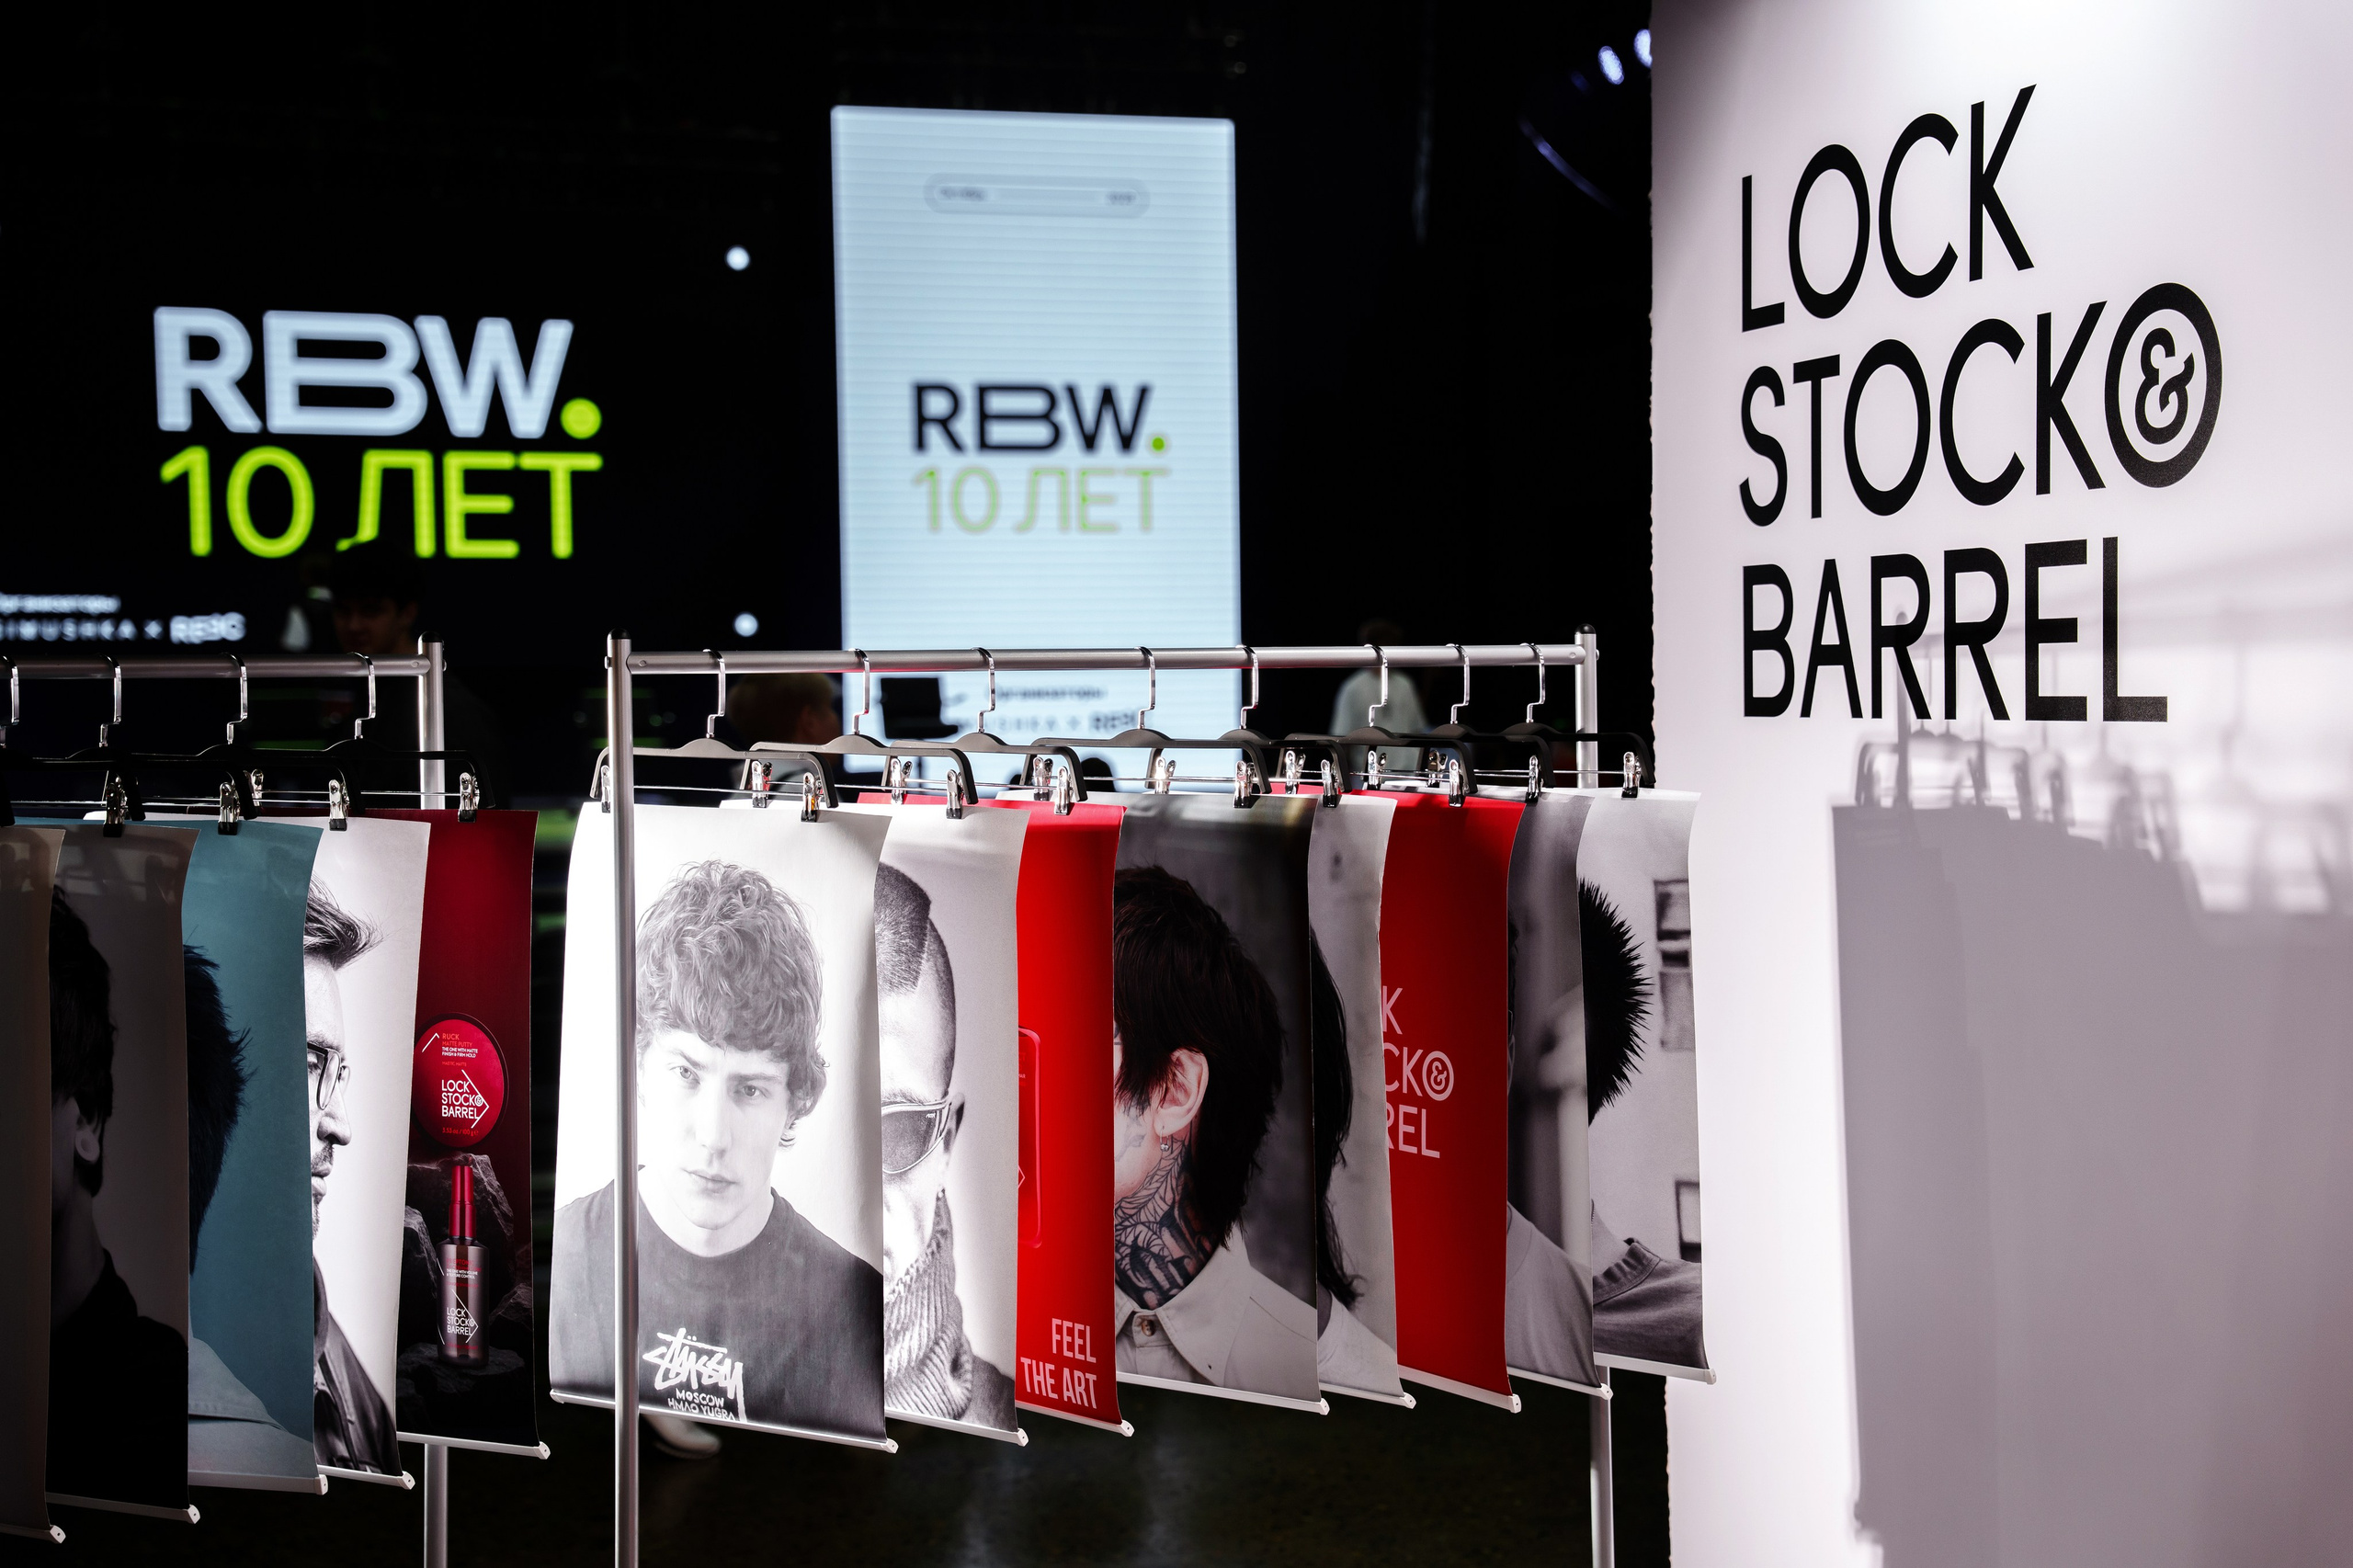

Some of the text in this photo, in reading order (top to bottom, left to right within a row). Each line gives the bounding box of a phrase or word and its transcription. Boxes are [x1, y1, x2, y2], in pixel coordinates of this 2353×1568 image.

[1742, 84, 2037, 333] LOCK
[160, 446, 602, 559] 10 ЛЕТ
[913, 466, 1170, 533] 10 ЛЕТ
[1743, 536, 2167, 723] BARREL
[442, 1079, 470, 1093] LOCK
[442, 1105, 479, 1119] BARREL
[447, 1307, 466, 1317] LOCK
[447, 1325, 472, 1335] BARREL
[1051, 1317, 1097, 1363] FEEL
[676, 1388, 724, 1407] MOSCOW
[1020, 1357, 1097, 1409] THE ART
